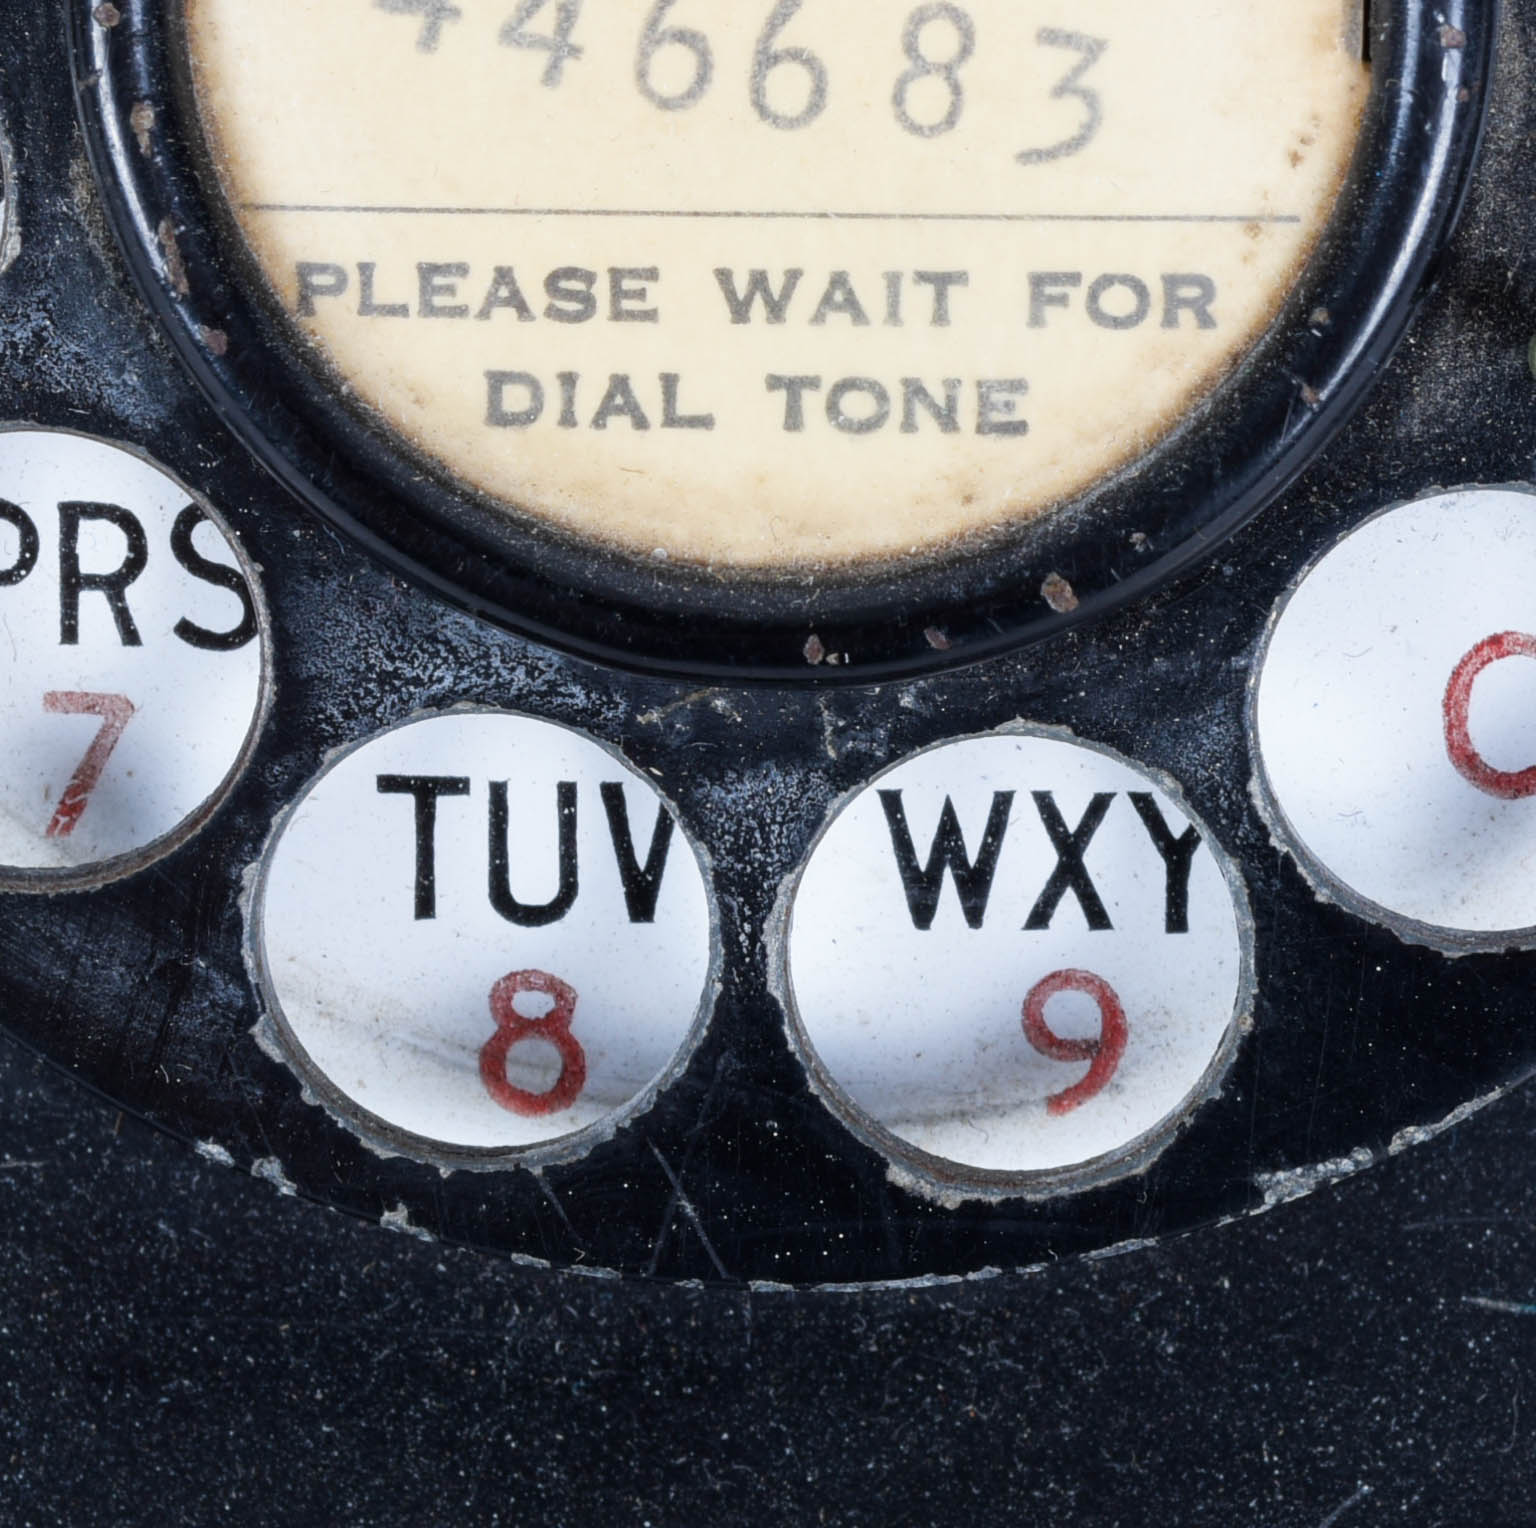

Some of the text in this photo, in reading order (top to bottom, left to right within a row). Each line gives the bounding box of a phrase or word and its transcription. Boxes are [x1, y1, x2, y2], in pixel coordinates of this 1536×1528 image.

[295, 261, 1217, 330] PLEASE WAIT FOR
[483, 370, 1030, 436] DIAL TONE
[42, 690, 136, 838] 7
[376, 774, 675, 928] TUV
[878, 788, 1201, 934] WXY
[478, 969, 587, 1118] 8
[1020, 968, 1128, 1117] 9
